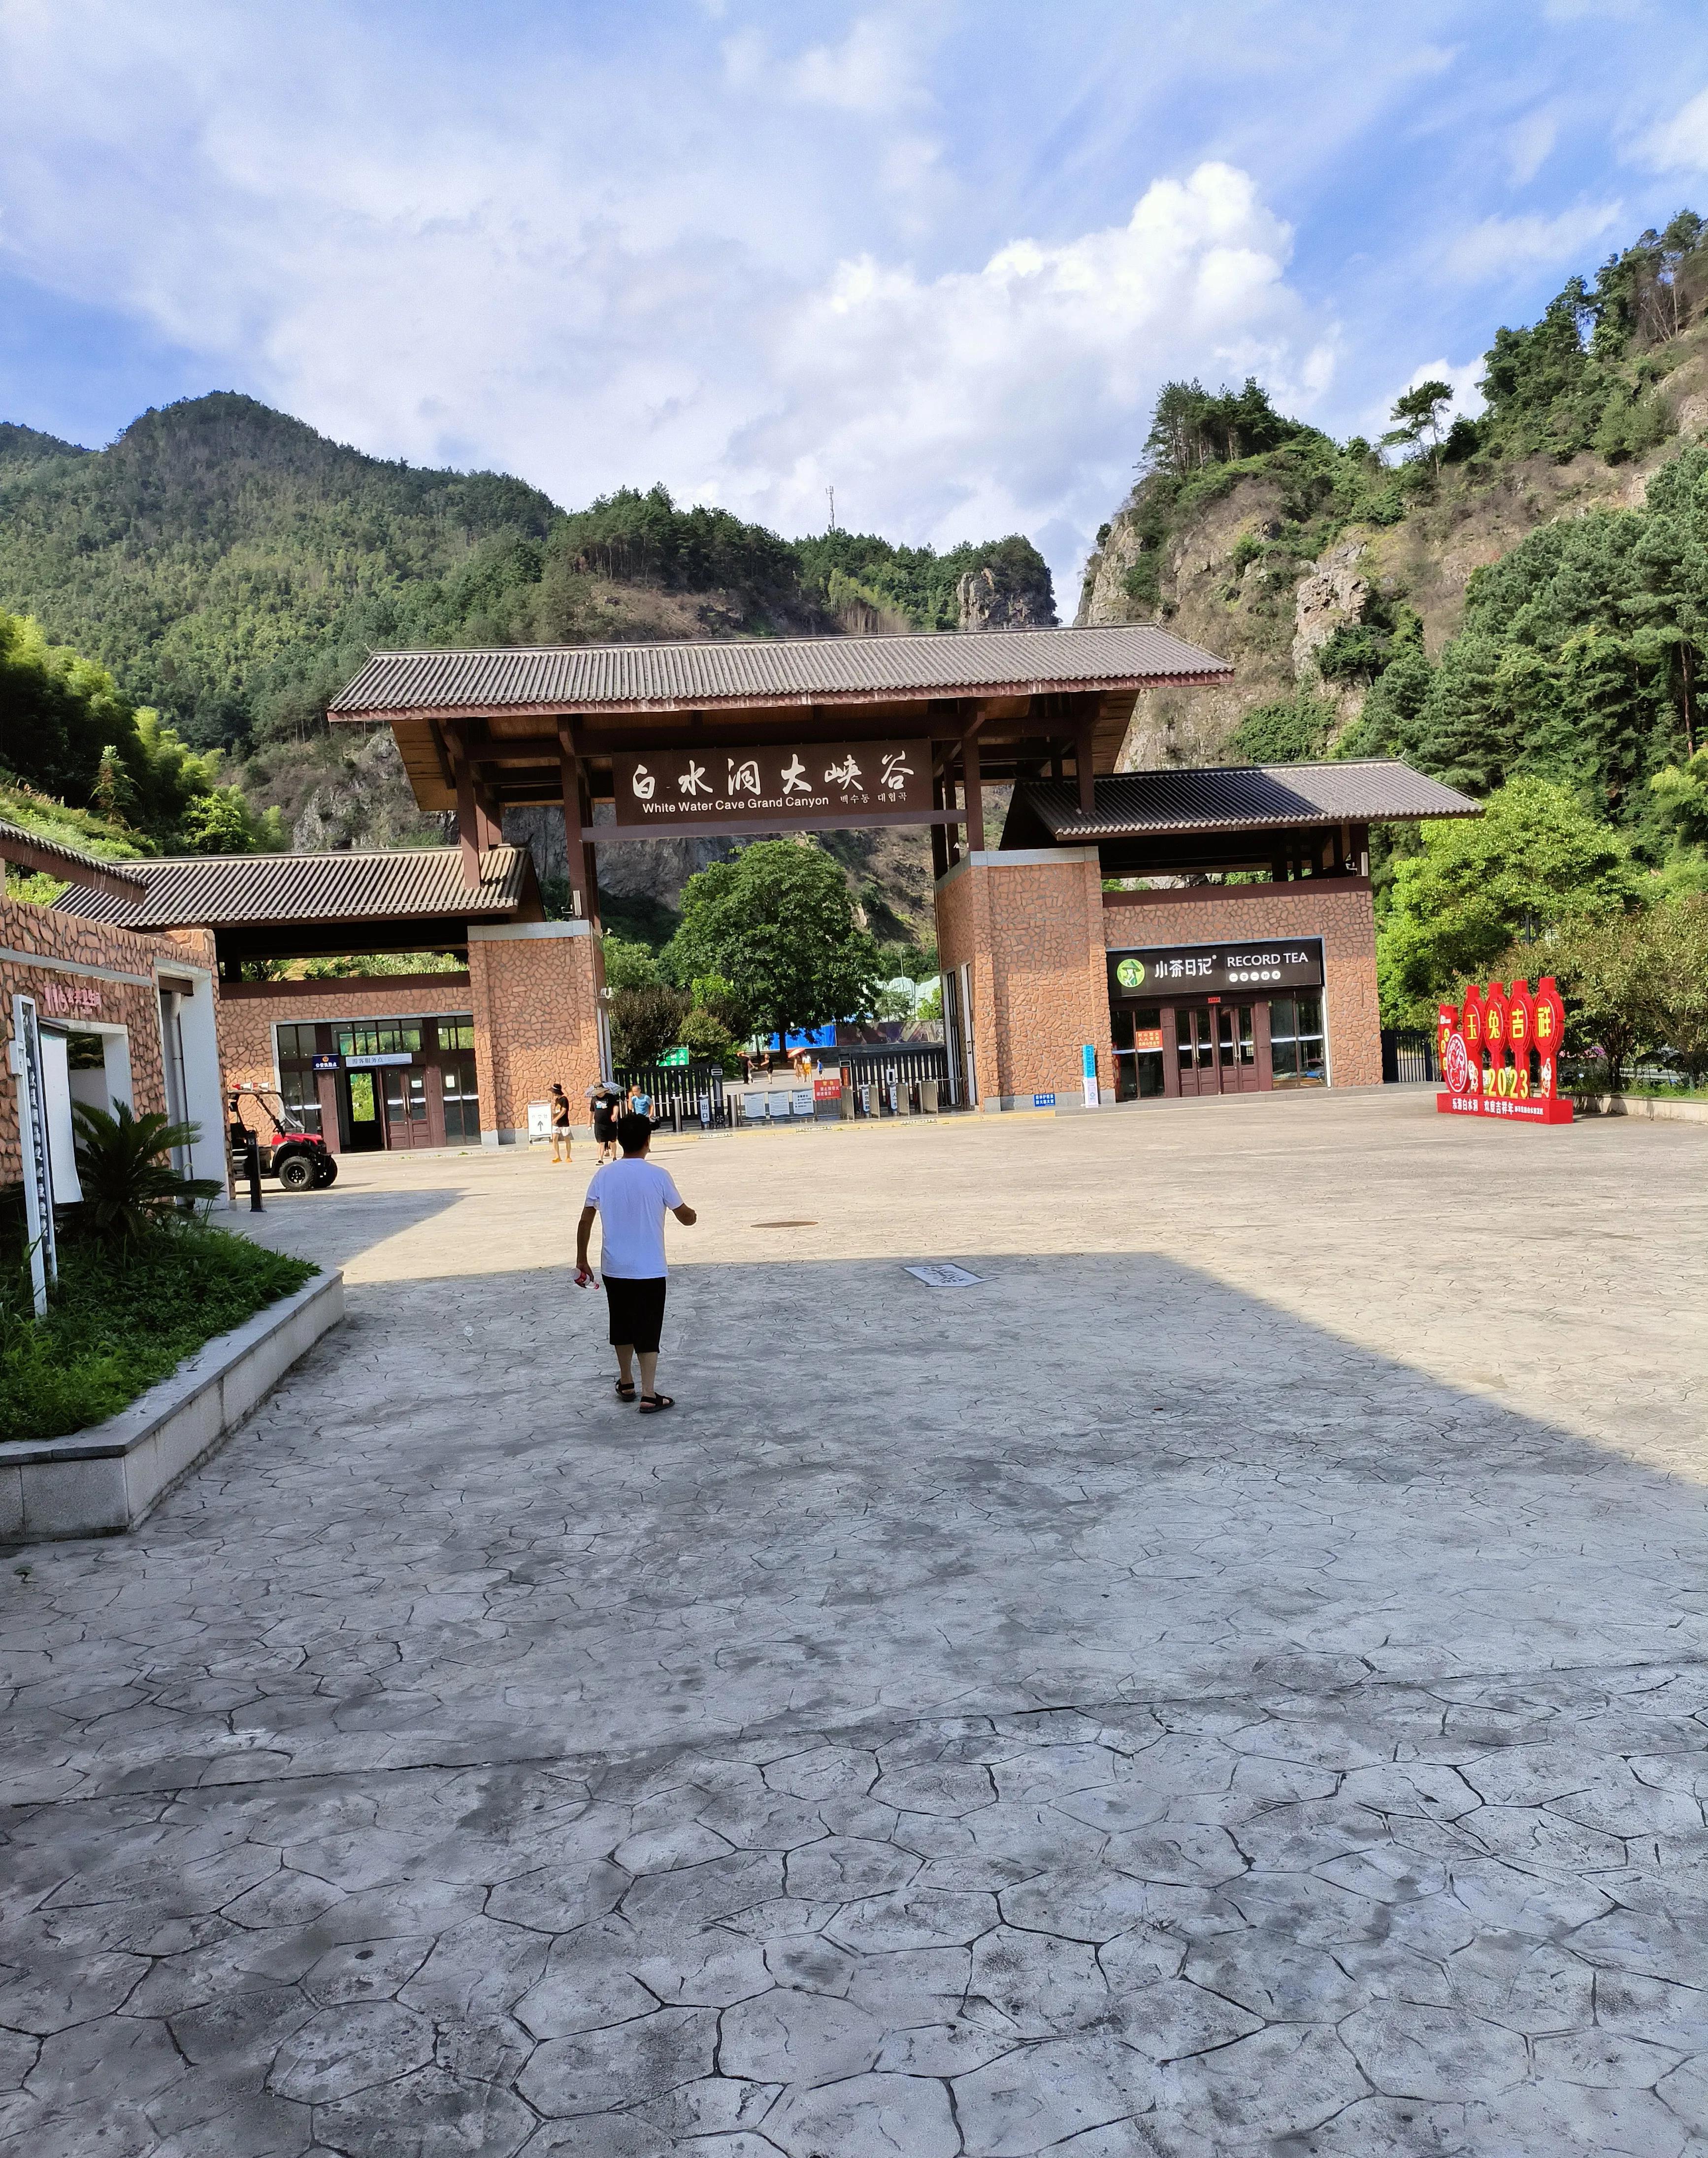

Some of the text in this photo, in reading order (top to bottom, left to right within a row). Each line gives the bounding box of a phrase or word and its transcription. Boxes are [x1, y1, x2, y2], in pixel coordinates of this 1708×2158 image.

[632, 750, 914, 799] 白水洞大峡谷
[643, 797, 829, 813] White Water Cave Grand Canyon
[840, 792, 907, 804] 백수동 대협곡
[1154, 958, 1213, 978] 小茶日记
[1227, 952, 1309, 967] RECORD TEA
[1467, 1006, 1551, 1039] 玉兔吉祥
[1488, 1068, 1528, 1099] 2023
[702, 1104, 708, 1118] 出口
